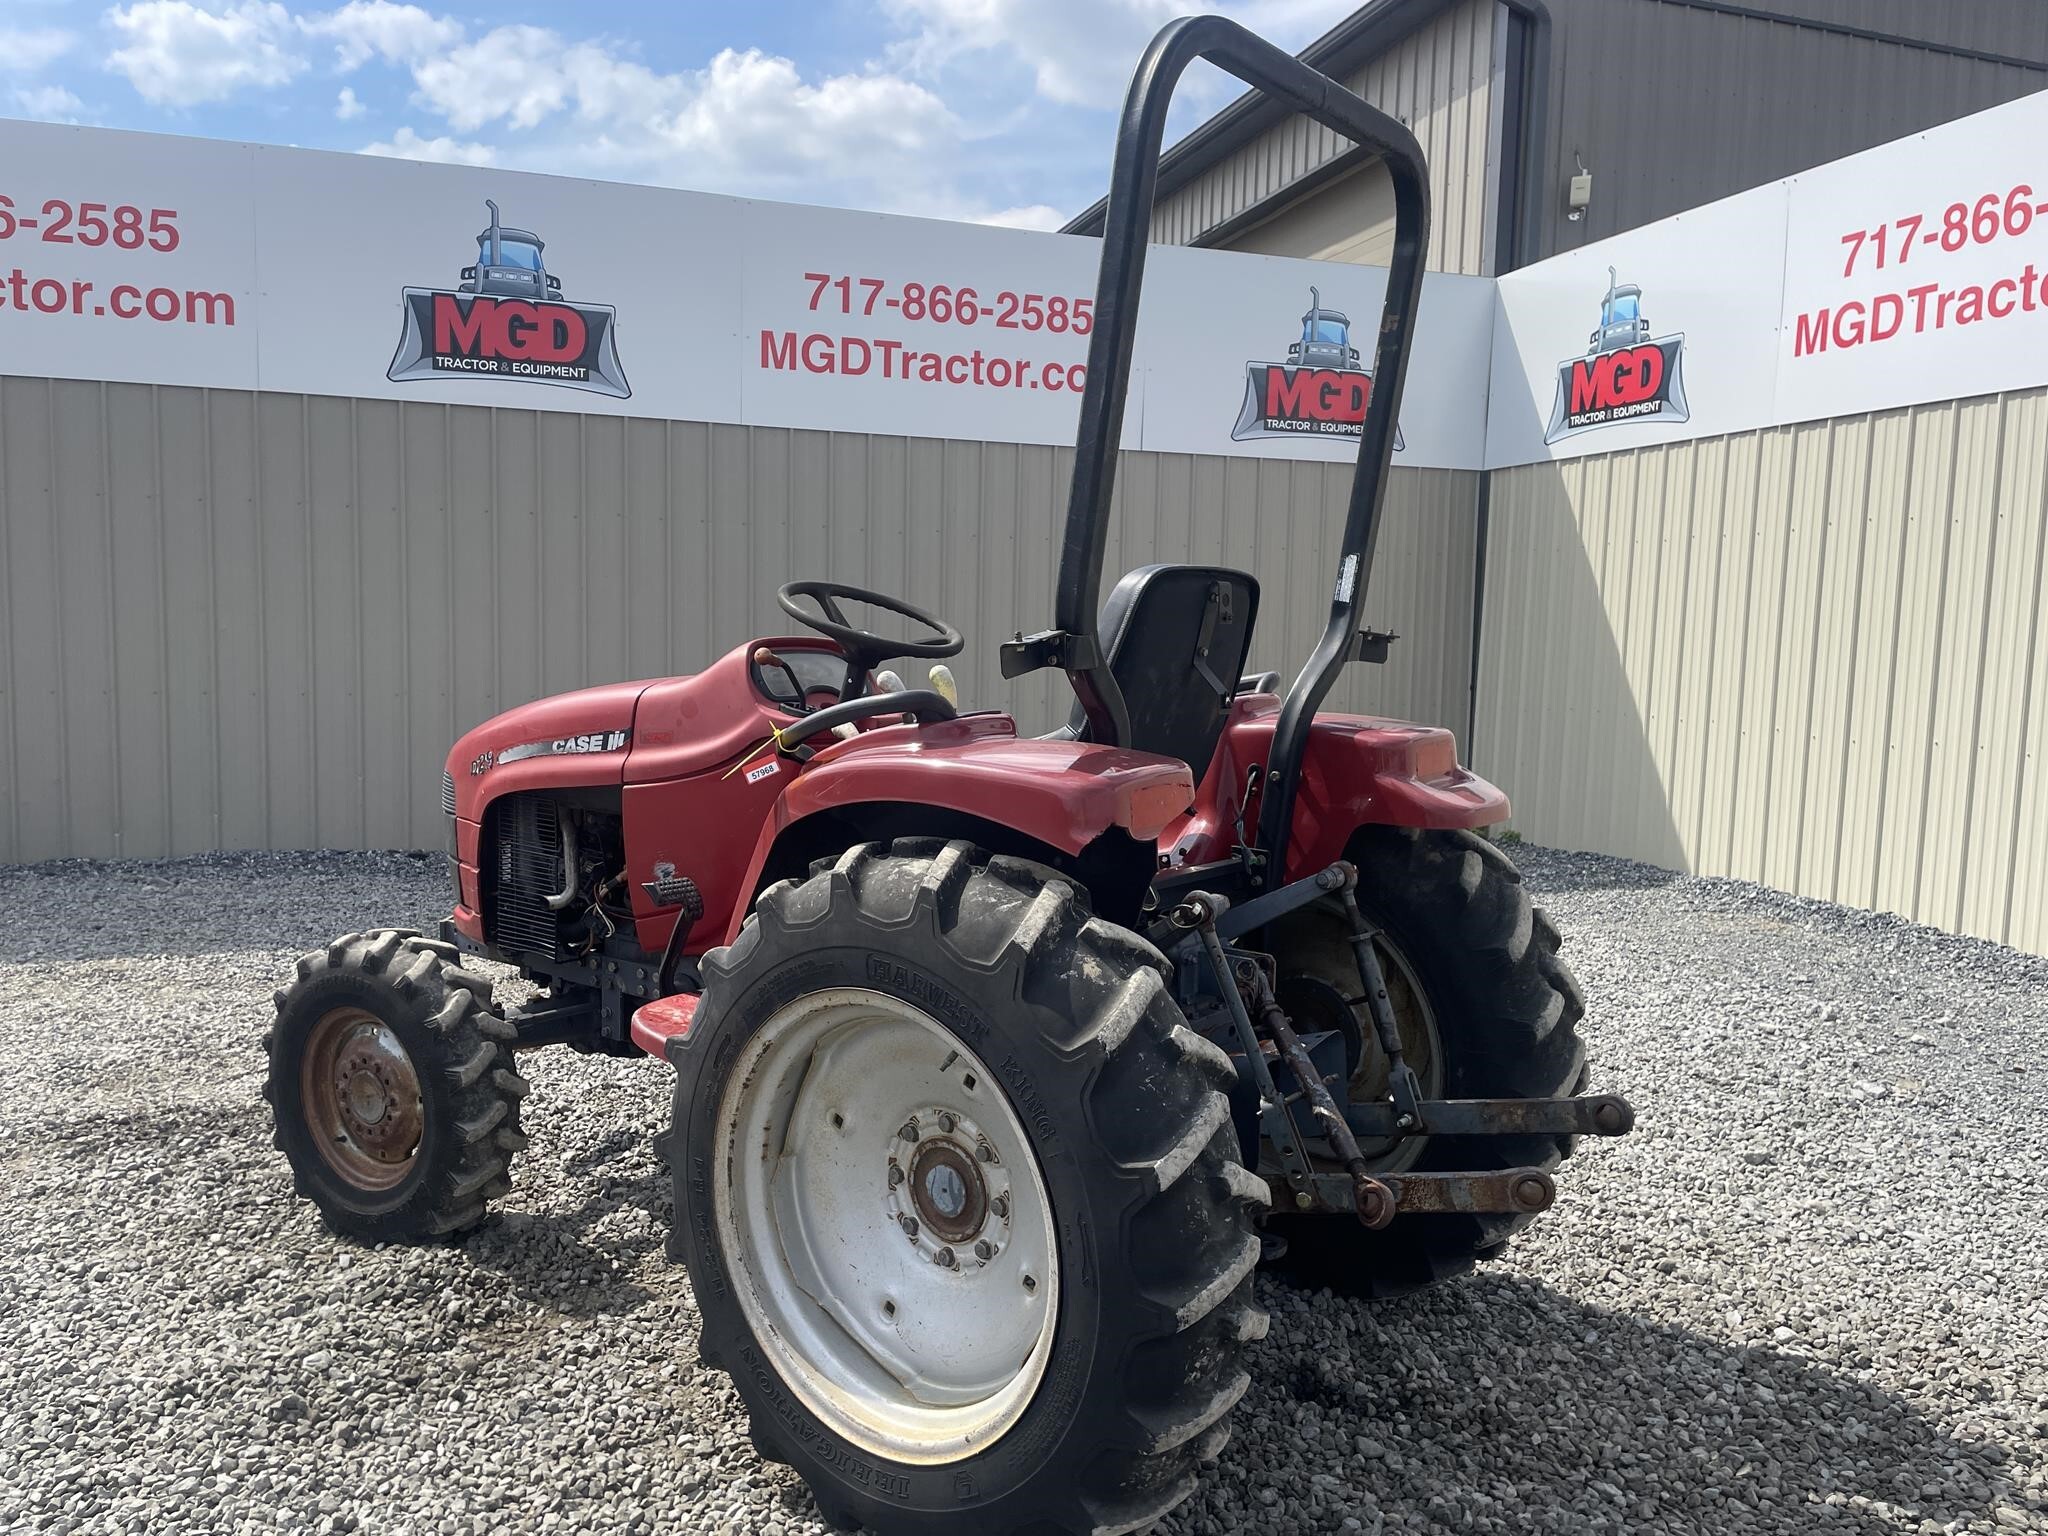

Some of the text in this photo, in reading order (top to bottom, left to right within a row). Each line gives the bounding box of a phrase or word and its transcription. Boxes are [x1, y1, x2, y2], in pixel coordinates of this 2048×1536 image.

[0, 269, 235, 326] tor.com
[804, 272, 1094, 335] 717-866-2585
[1794, 264, 2048, 358] MGDTract
[433, 294, 587, 363] MGD
[436, 356, 498, 371] TRACTOR
[512, 363, 587, 378] EQUIPMENT
[1266, 366, 1371, 422] MGD
[1571, 345, 1664, 414] MGD
[1267, 419, 1311, 431] TRACTOR
[1570, 410, 1606, 426] TRACTOR
[1613, 400, 1661, 419] EQUIPMENT
[552, 734, 604, 753] CASE
[751, 764, 775, 780] 57968
[872, 958, 1058, 1141] HARVEST KING
[740, 1344, 913, 1499] IRRIGATION
